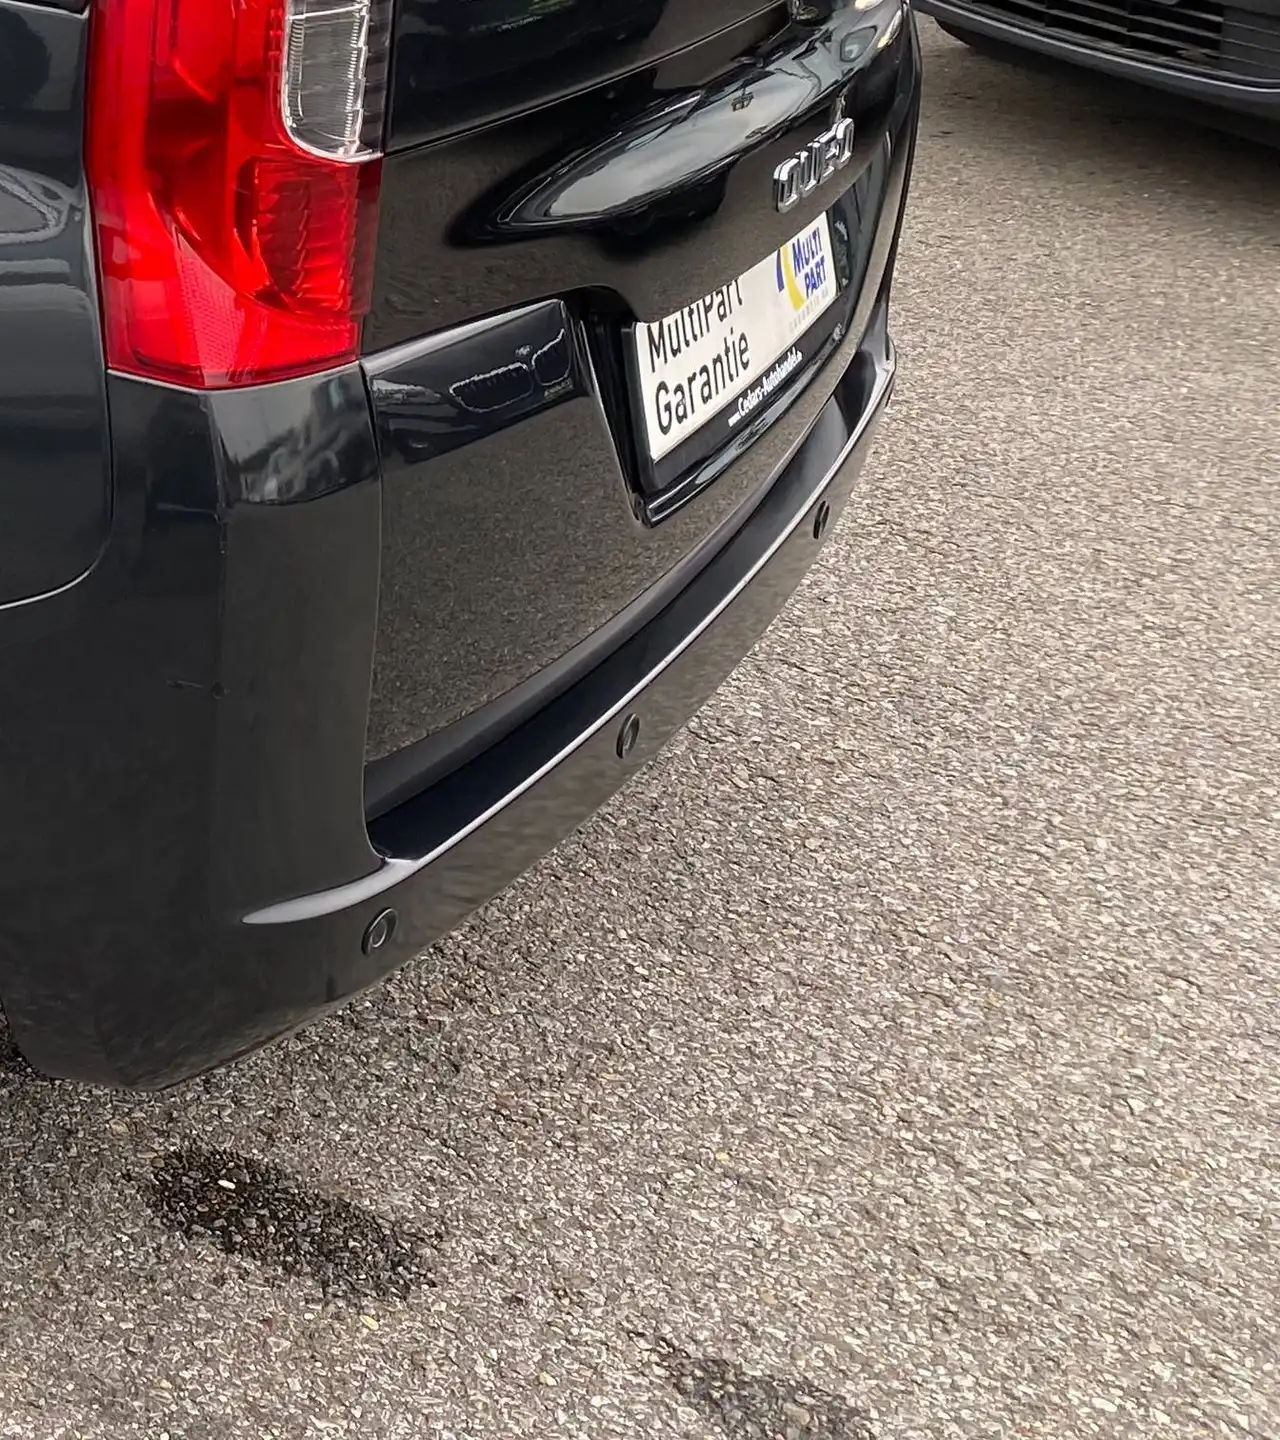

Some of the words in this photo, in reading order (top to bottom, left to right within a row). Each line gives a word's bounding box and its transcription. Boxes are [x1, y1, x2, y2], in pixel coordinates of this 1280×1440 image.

[792, 226, 823, 278] MULTI
[804, 255, 827, 299] PART
[655, 326, 750, 436] Garantie
